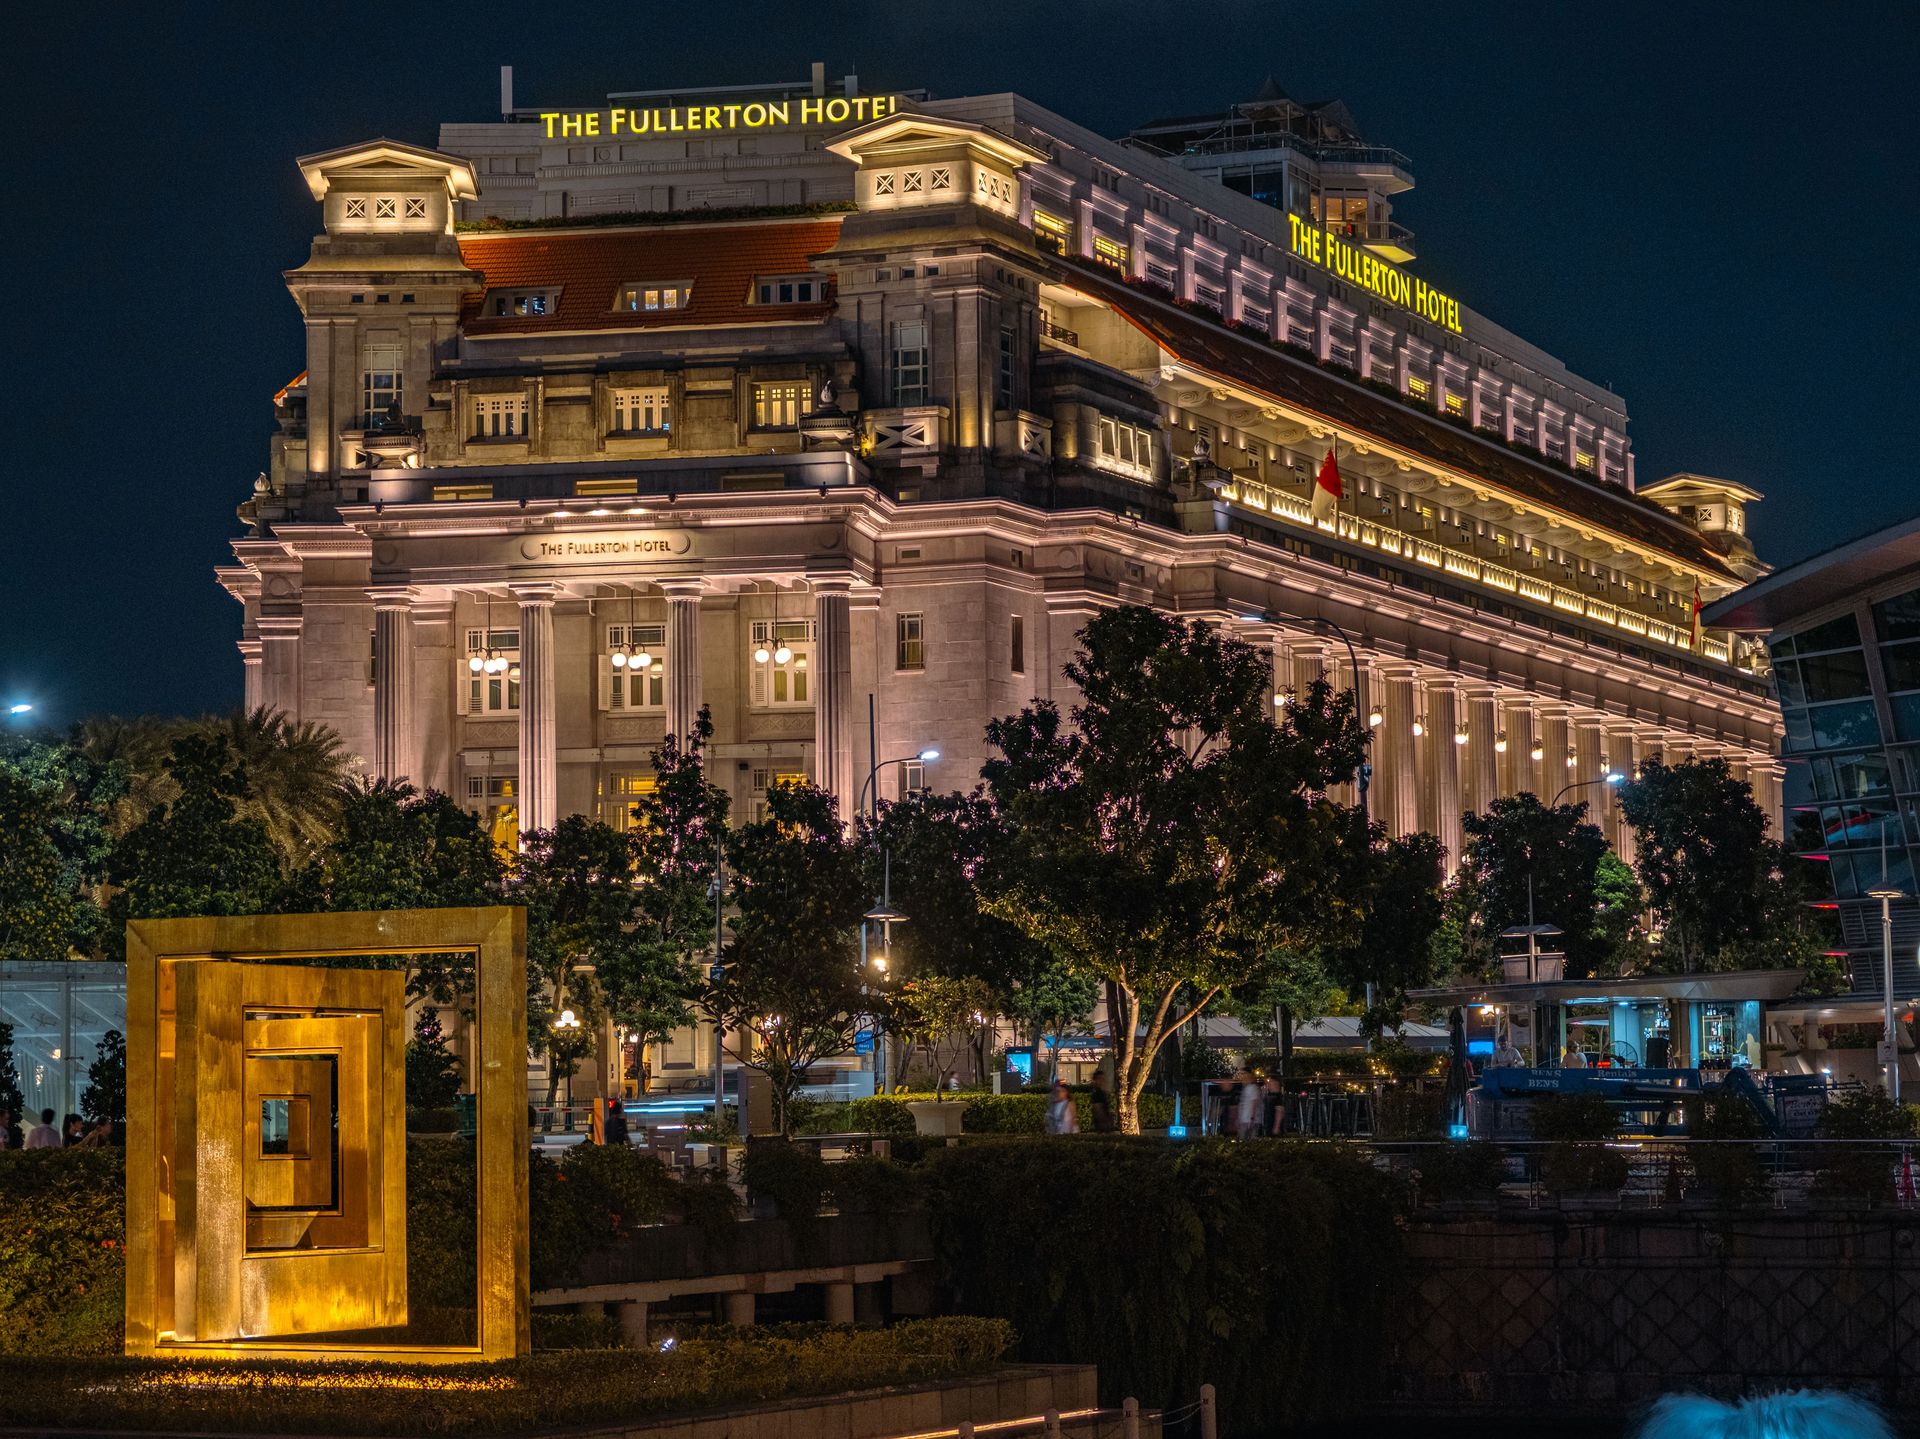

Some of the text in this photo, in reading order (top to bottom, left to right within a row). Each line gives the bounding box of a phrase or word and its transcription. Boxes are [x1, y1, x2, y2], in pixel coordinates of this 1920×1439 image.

[540, 112, 600, 139] THE
[610, 101, 789, 135] FULLERTON
[1288, 212, 1463, 334] THE FULLERTON HOTEL
[541, 539, 671, 555] THE FULLERTON HOTEL
